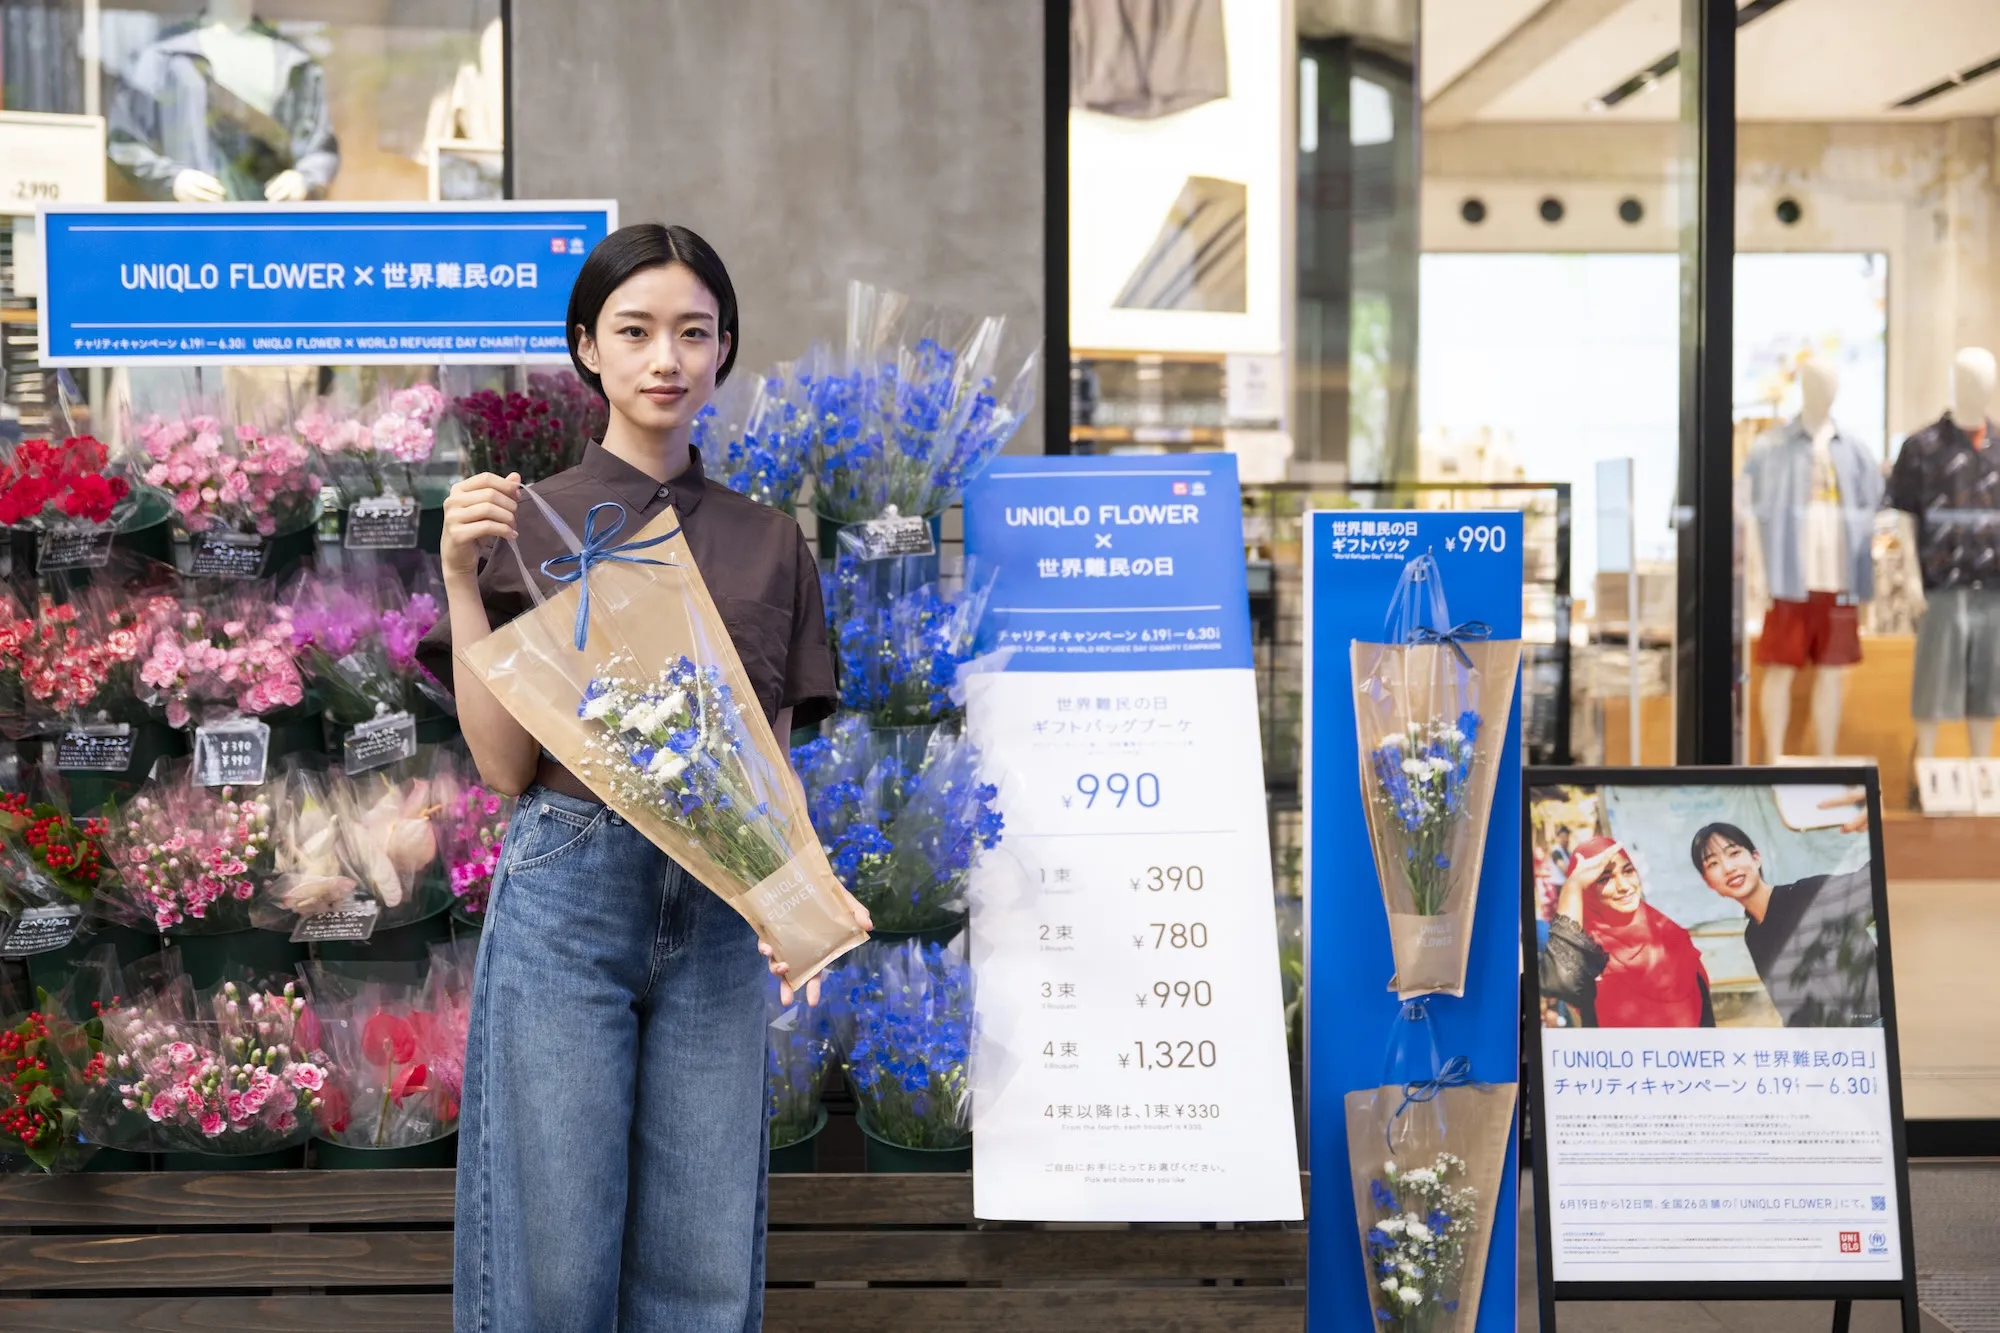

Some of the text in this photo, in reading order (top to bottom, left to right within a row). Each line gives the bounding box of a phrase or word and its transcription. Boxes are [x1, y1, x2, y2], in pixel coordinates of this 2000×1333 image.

[120, 262, 219, 291] UNIQLO
[229, 262, 345, 290] FLOWER
[382, 262, 538, 289] 世界難民の日
[73, 337, 178, 350] チャリティキャンペーン
[252, 337, 292, 350] UNIQLO
[296, 337, 342, 350] FLOWER
[356, 337, 398, 350] WORLD
[400, 337, 454, 349] REFUGEE
[455, 337, 478, 349] DAY
[479, 337, 527, 349] CHARITY
[1005, 504, 1200, 528] UNIQLO FLOWER
[1331, 520, 1418, 537] 世界難民の日
[1037, 557, 1175, 579] 世界難民の日
[1057, 696, 1168, 713] 世界難民の日
[760, 871, 804, 907] UNIQLO
[767, 883, 817, 922] FLOWER
[1642, 1050, 1726, 1069] FLOWER
[1553, 1077, 1748, 1096] チャリティキャンペーン
[1840, 1233, 1858, 1242] UNI
[1841, 1242, 1859, 1252] QLO
